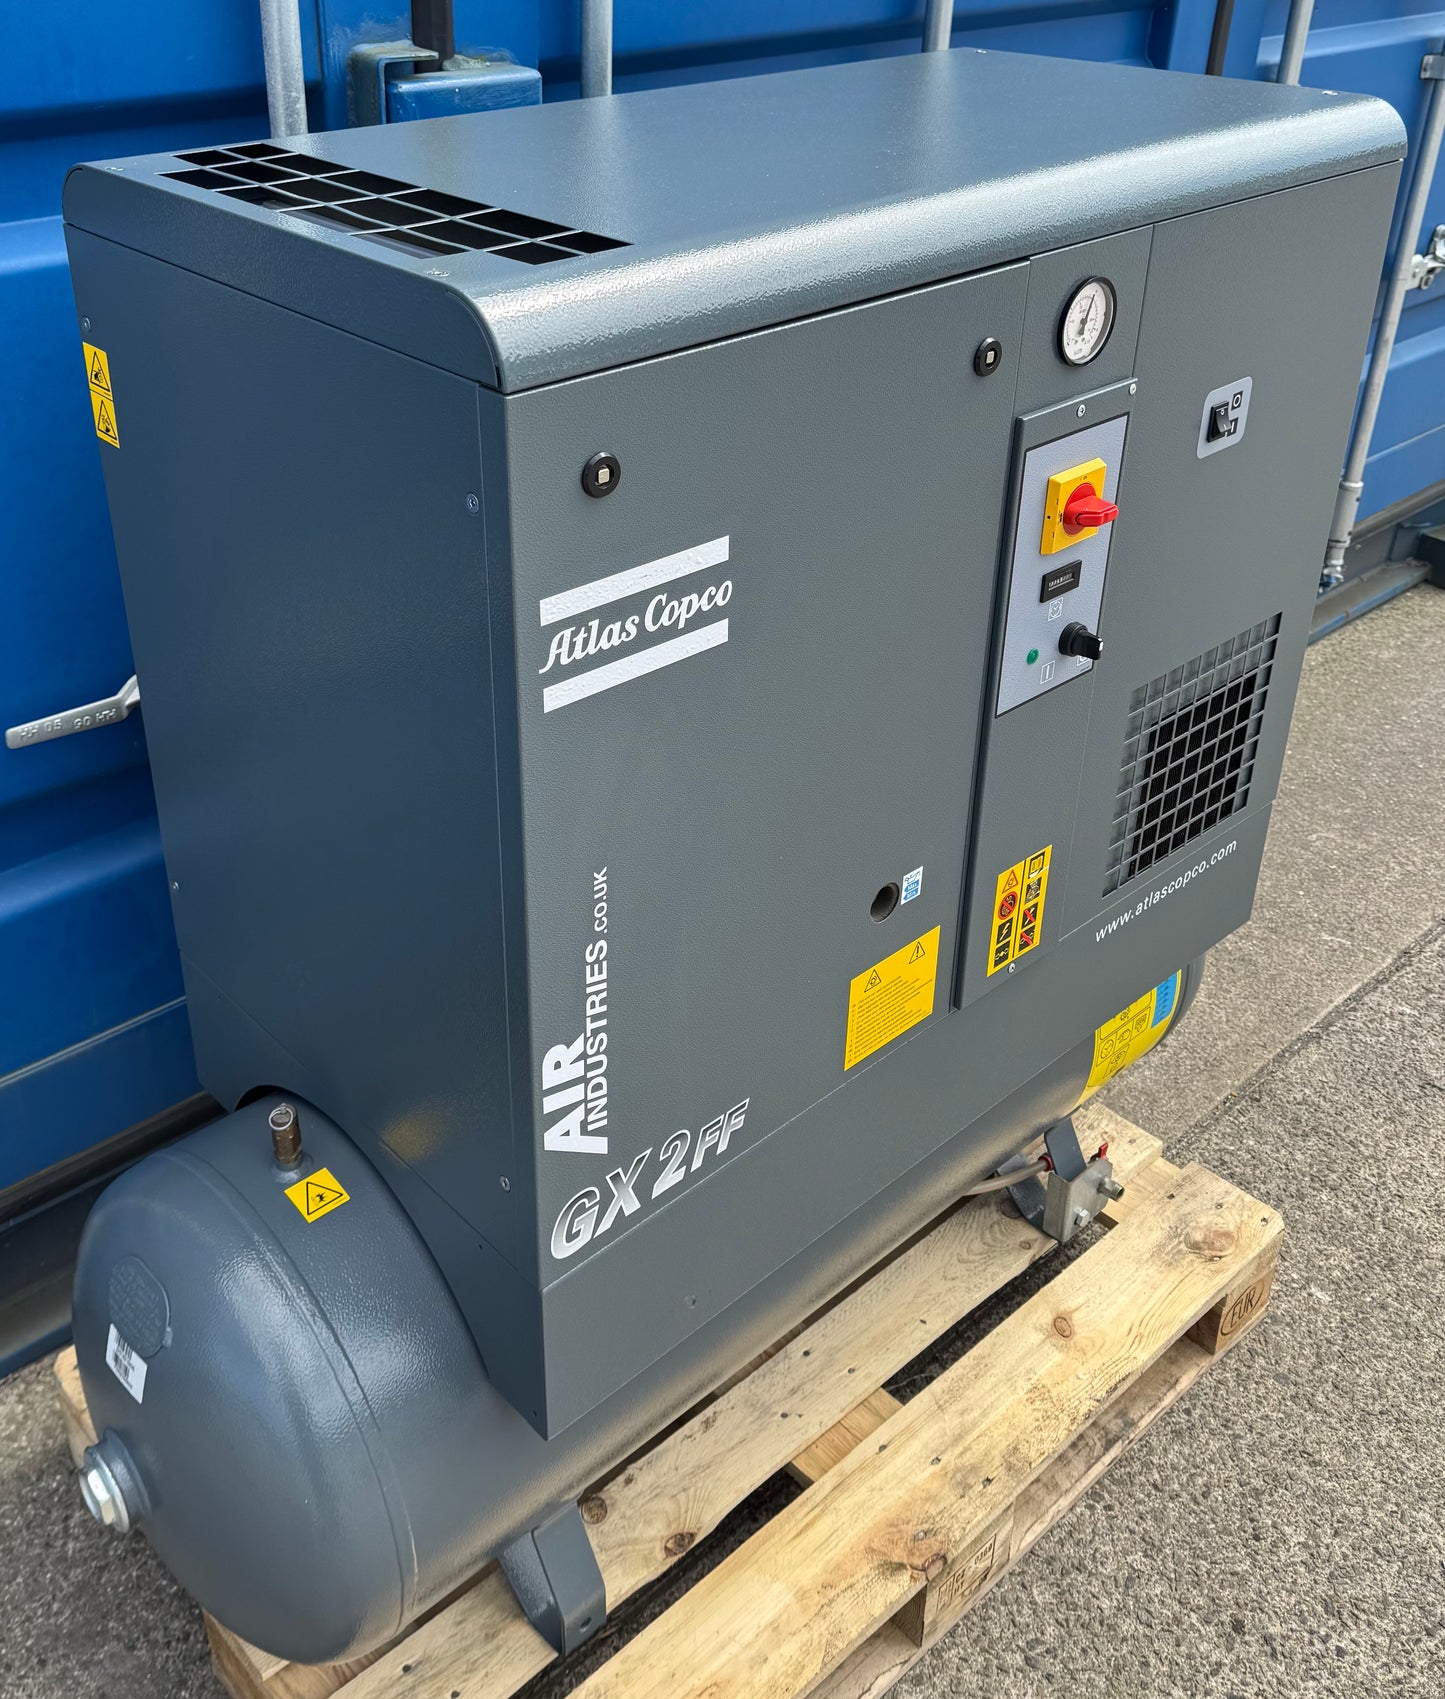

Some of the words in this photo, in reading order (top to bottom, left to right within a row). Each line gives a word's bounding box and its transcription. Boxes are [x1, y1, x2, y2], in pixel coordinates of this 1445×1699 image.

[538, 615, 640, 674] Atlas
[644, 580, 733, 632] Copco
[1095, 840, 1237, 942] www.atlascopco.com
[585, 941, 608, 1131] INDUSTRIES
[542, 1033, 608, 1154] AIR
[550, 1147, 653, 1260] GX
[1230, 1286, 1255, 1328] EUR
